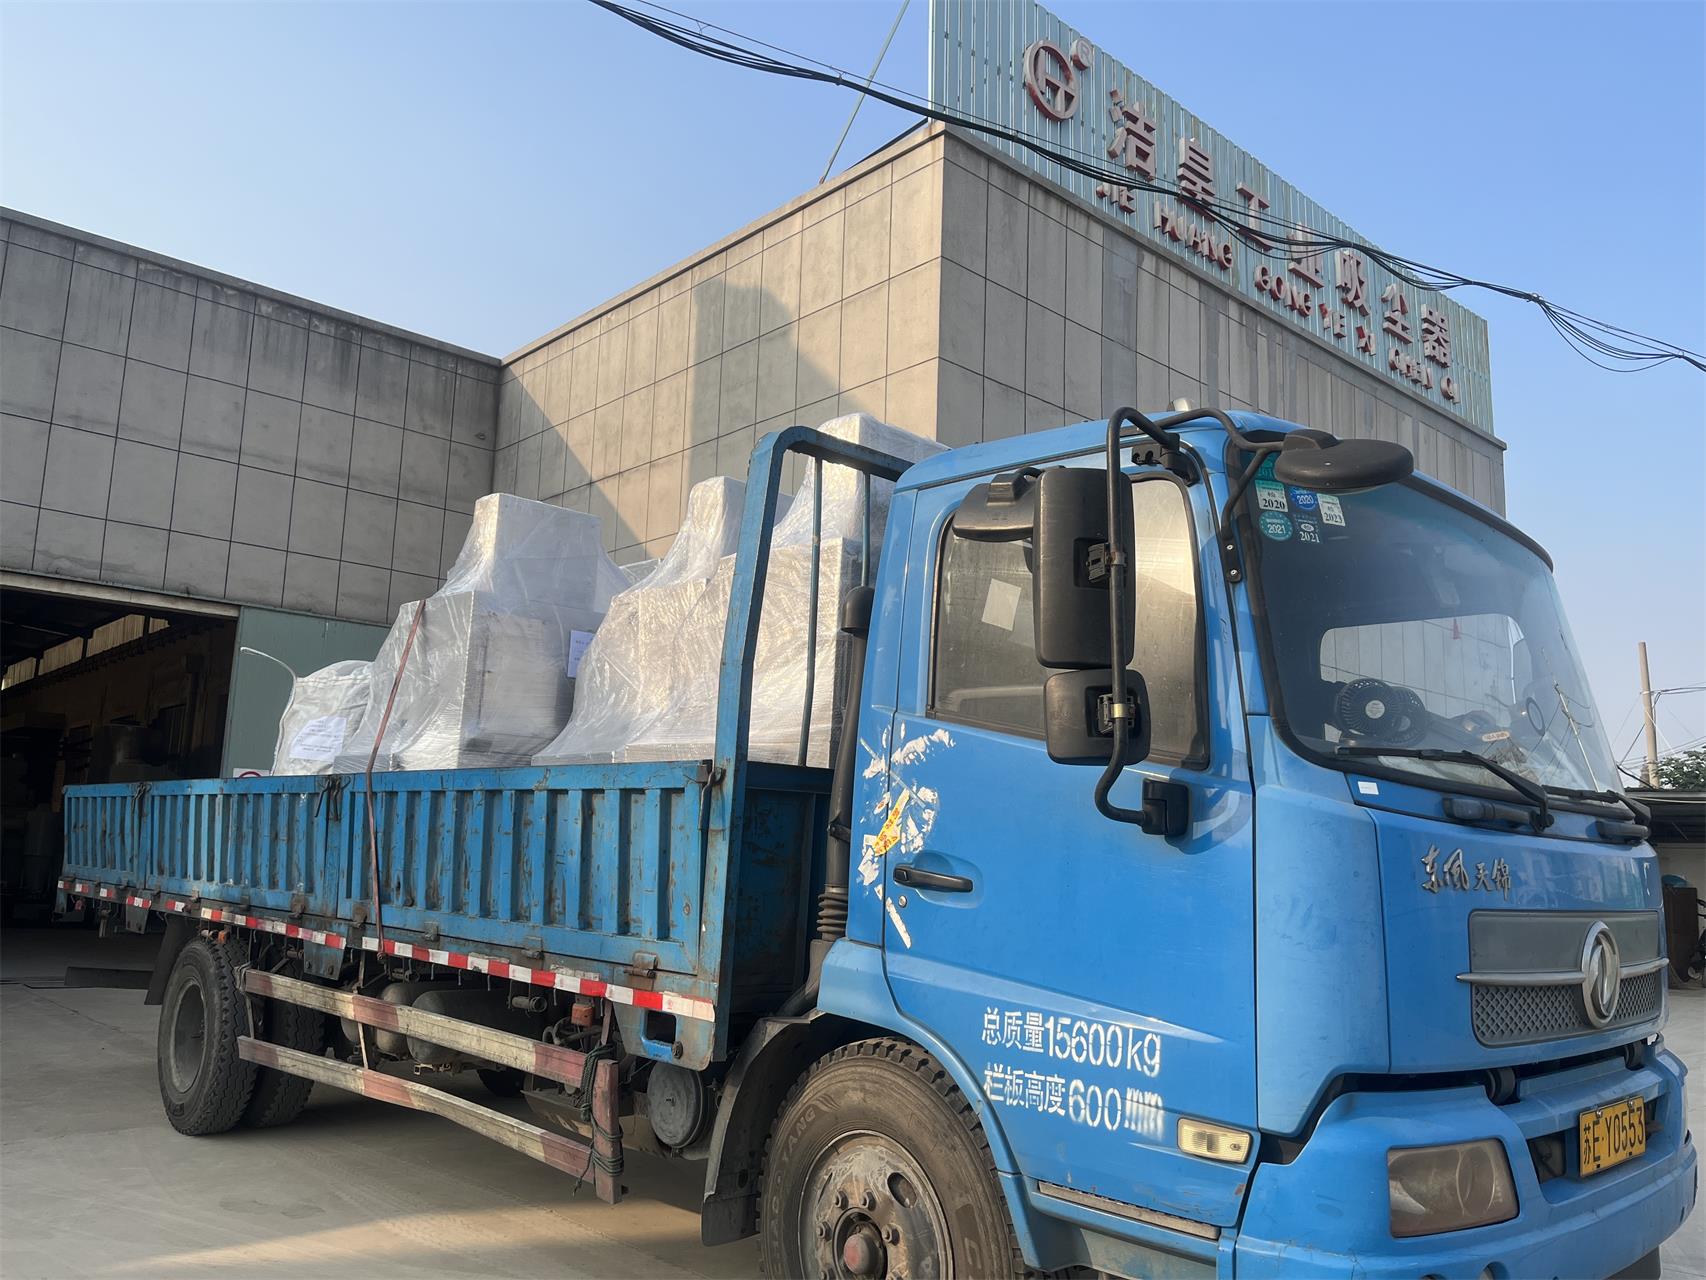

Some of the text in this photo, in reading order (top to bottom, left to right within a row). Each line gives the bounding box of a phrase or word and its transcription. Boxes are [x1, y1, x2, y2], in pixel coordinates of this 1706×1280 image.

[1108, 89, 1452, 369] 洁皇工业吸尘器
[1153, 201, 1234, 271] HUANG
[1254, 264, 1313, 317] GONG
[1319, 304, 1347, 339] YE
[1388, 347, 1433, 390] CHEN
[1440, 375, 1461, 404] QI
[1263, 498, 1286, 510] 2020
[1267, 524, 1286, 534] 2021
[1300, 531, 1320, 543] 2021
[981, 1006, 1161, 1078] 总质量15600kg
